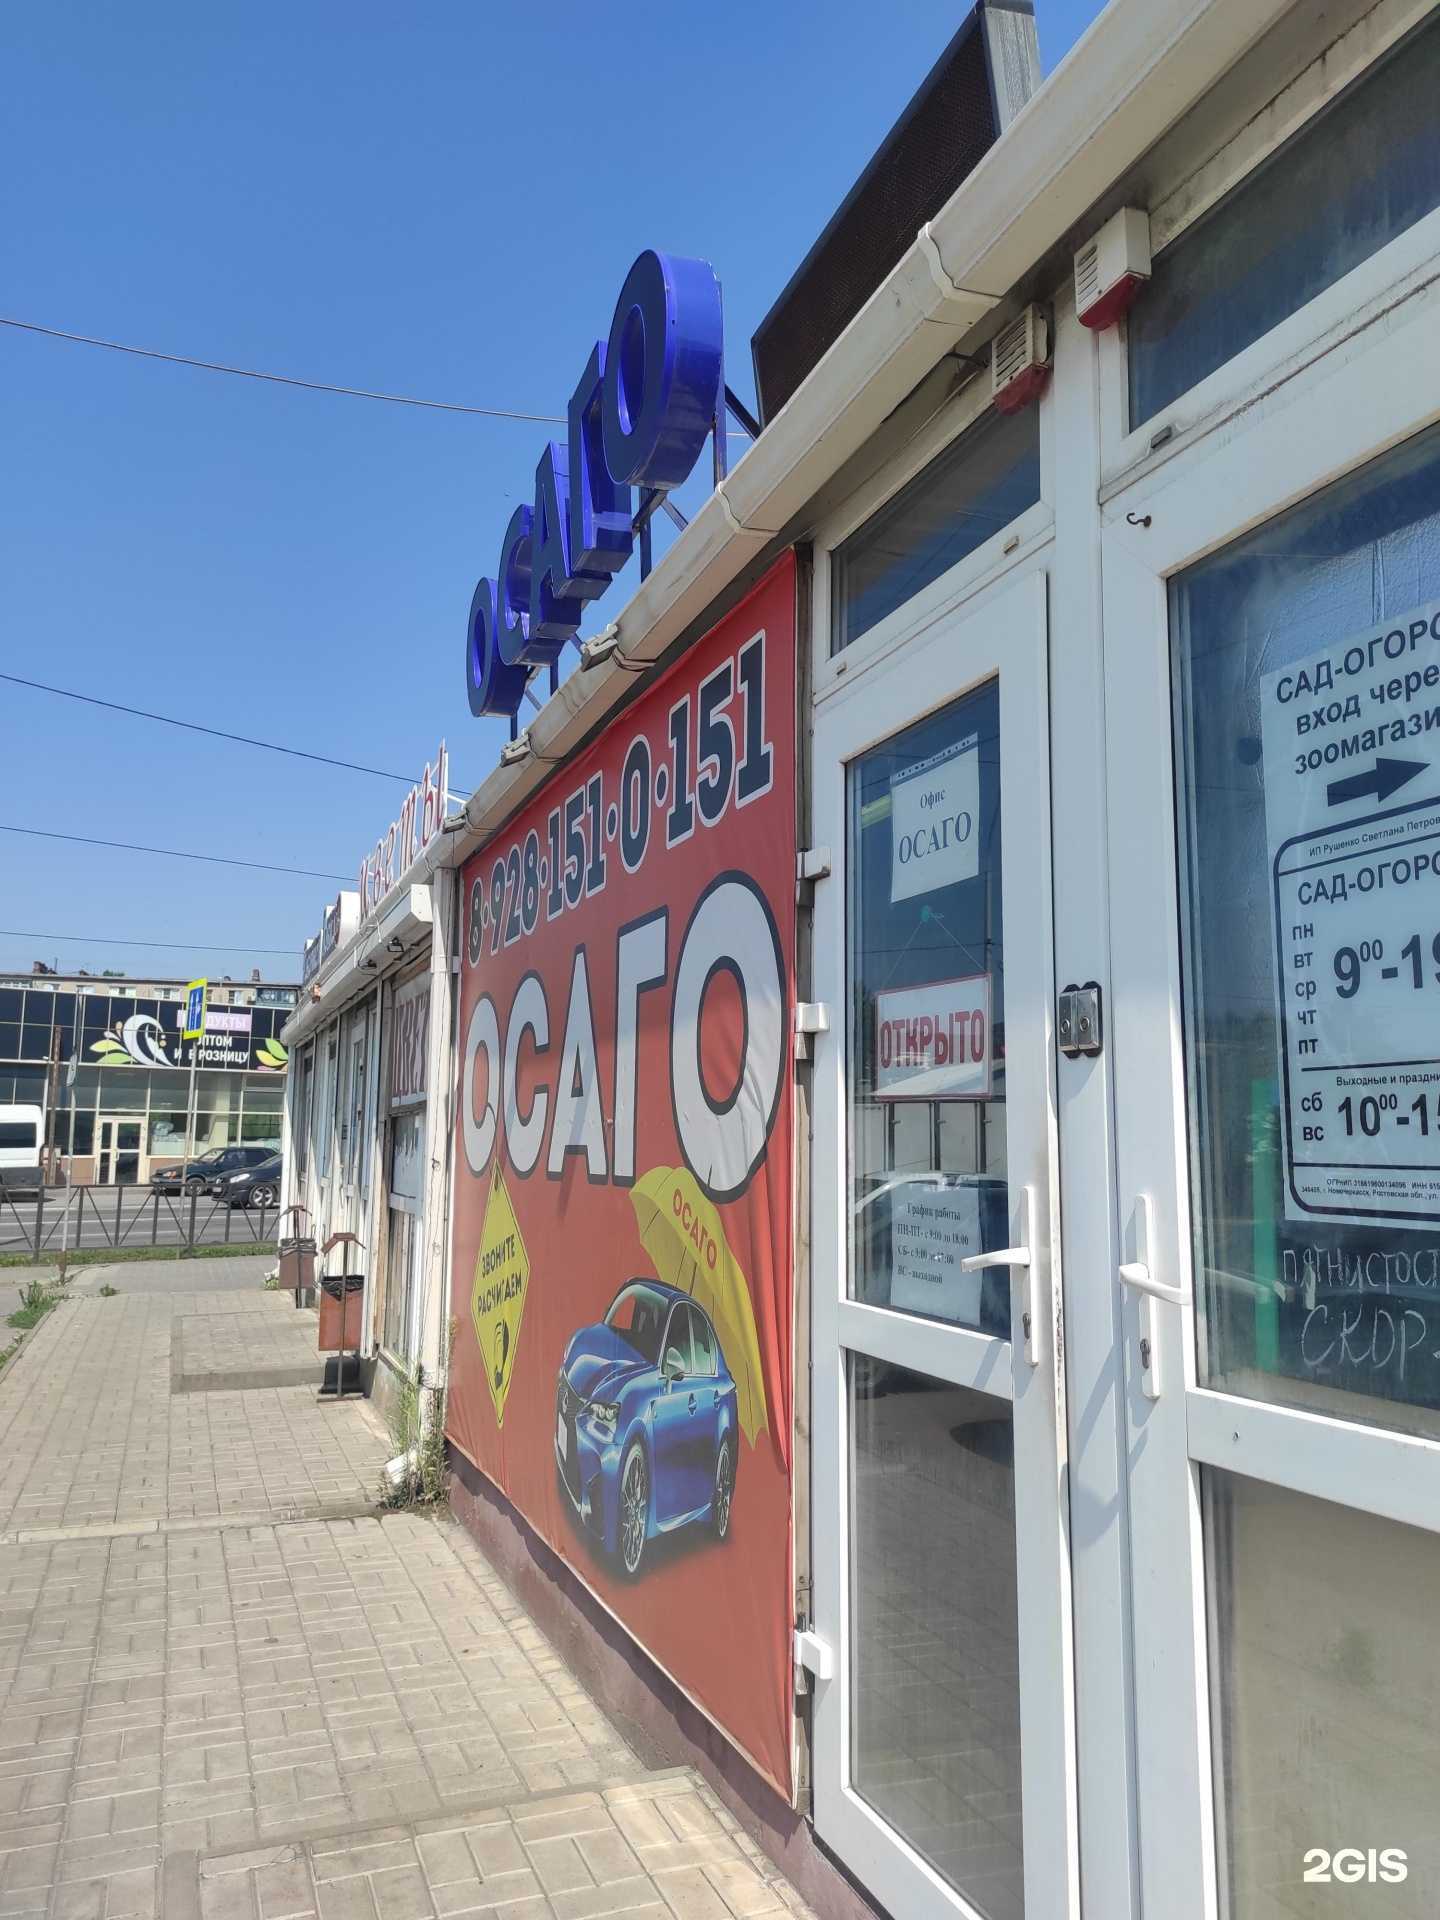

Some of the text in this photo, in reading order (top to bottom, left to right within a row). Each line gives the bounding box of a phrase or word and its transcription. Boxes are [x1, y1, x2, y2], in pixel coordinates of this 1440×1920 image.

[466, 249, 722, 718] ОСАГО
[1296, 664, 1440, 736] вход чере
[920, 789, 946, 809] Офис
[898, 811, 972, 864] ОСАГО
[1309, 846, 1321, 857] ИП
[1323, 837, 1360, 855] Рушенко
[1361, 826, 1405, 842] Светлана
[1295, 979, 1318, 1000] ср
[174, 1047, 183, 1060] И
[198, 1049, 250, 1064] РОЗНИЦУ
[462, 870, 787, 1204] ОСАГО
[880, 1008, 985, 1069] ОТКРЫТО
[1336, 1076, 1387, 1087] Выходные
[1390, 1075, 1397, 1084] и
[673, 1188, 717, 1270] ОСАГО
[481, 1233, 515, 1278] ЗВОНИТЕ
